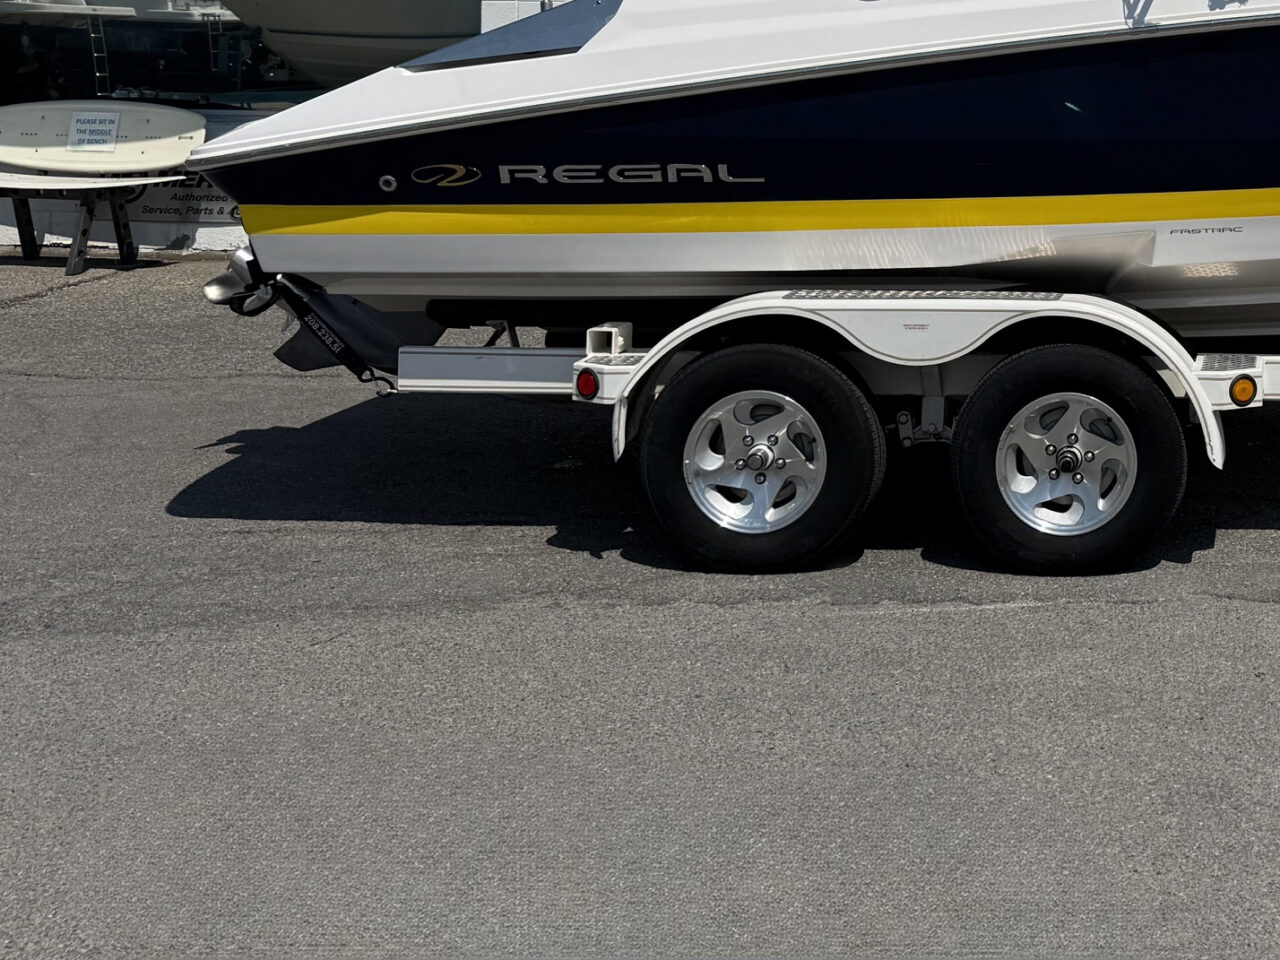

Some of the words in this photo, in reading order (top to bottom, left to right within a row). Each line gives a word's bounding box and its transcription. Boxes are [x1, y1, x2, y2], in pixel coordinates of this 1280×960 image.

[89, 128, 113, 136] MIDDLE
[498, 163, 765, 184] REGAL
[141, 205, 182, 216] Service,
[185, 206, 214, 215] Parts
[217, 206, 225, 215] &
[1169, 226, 1244, 235] FASTRAC
